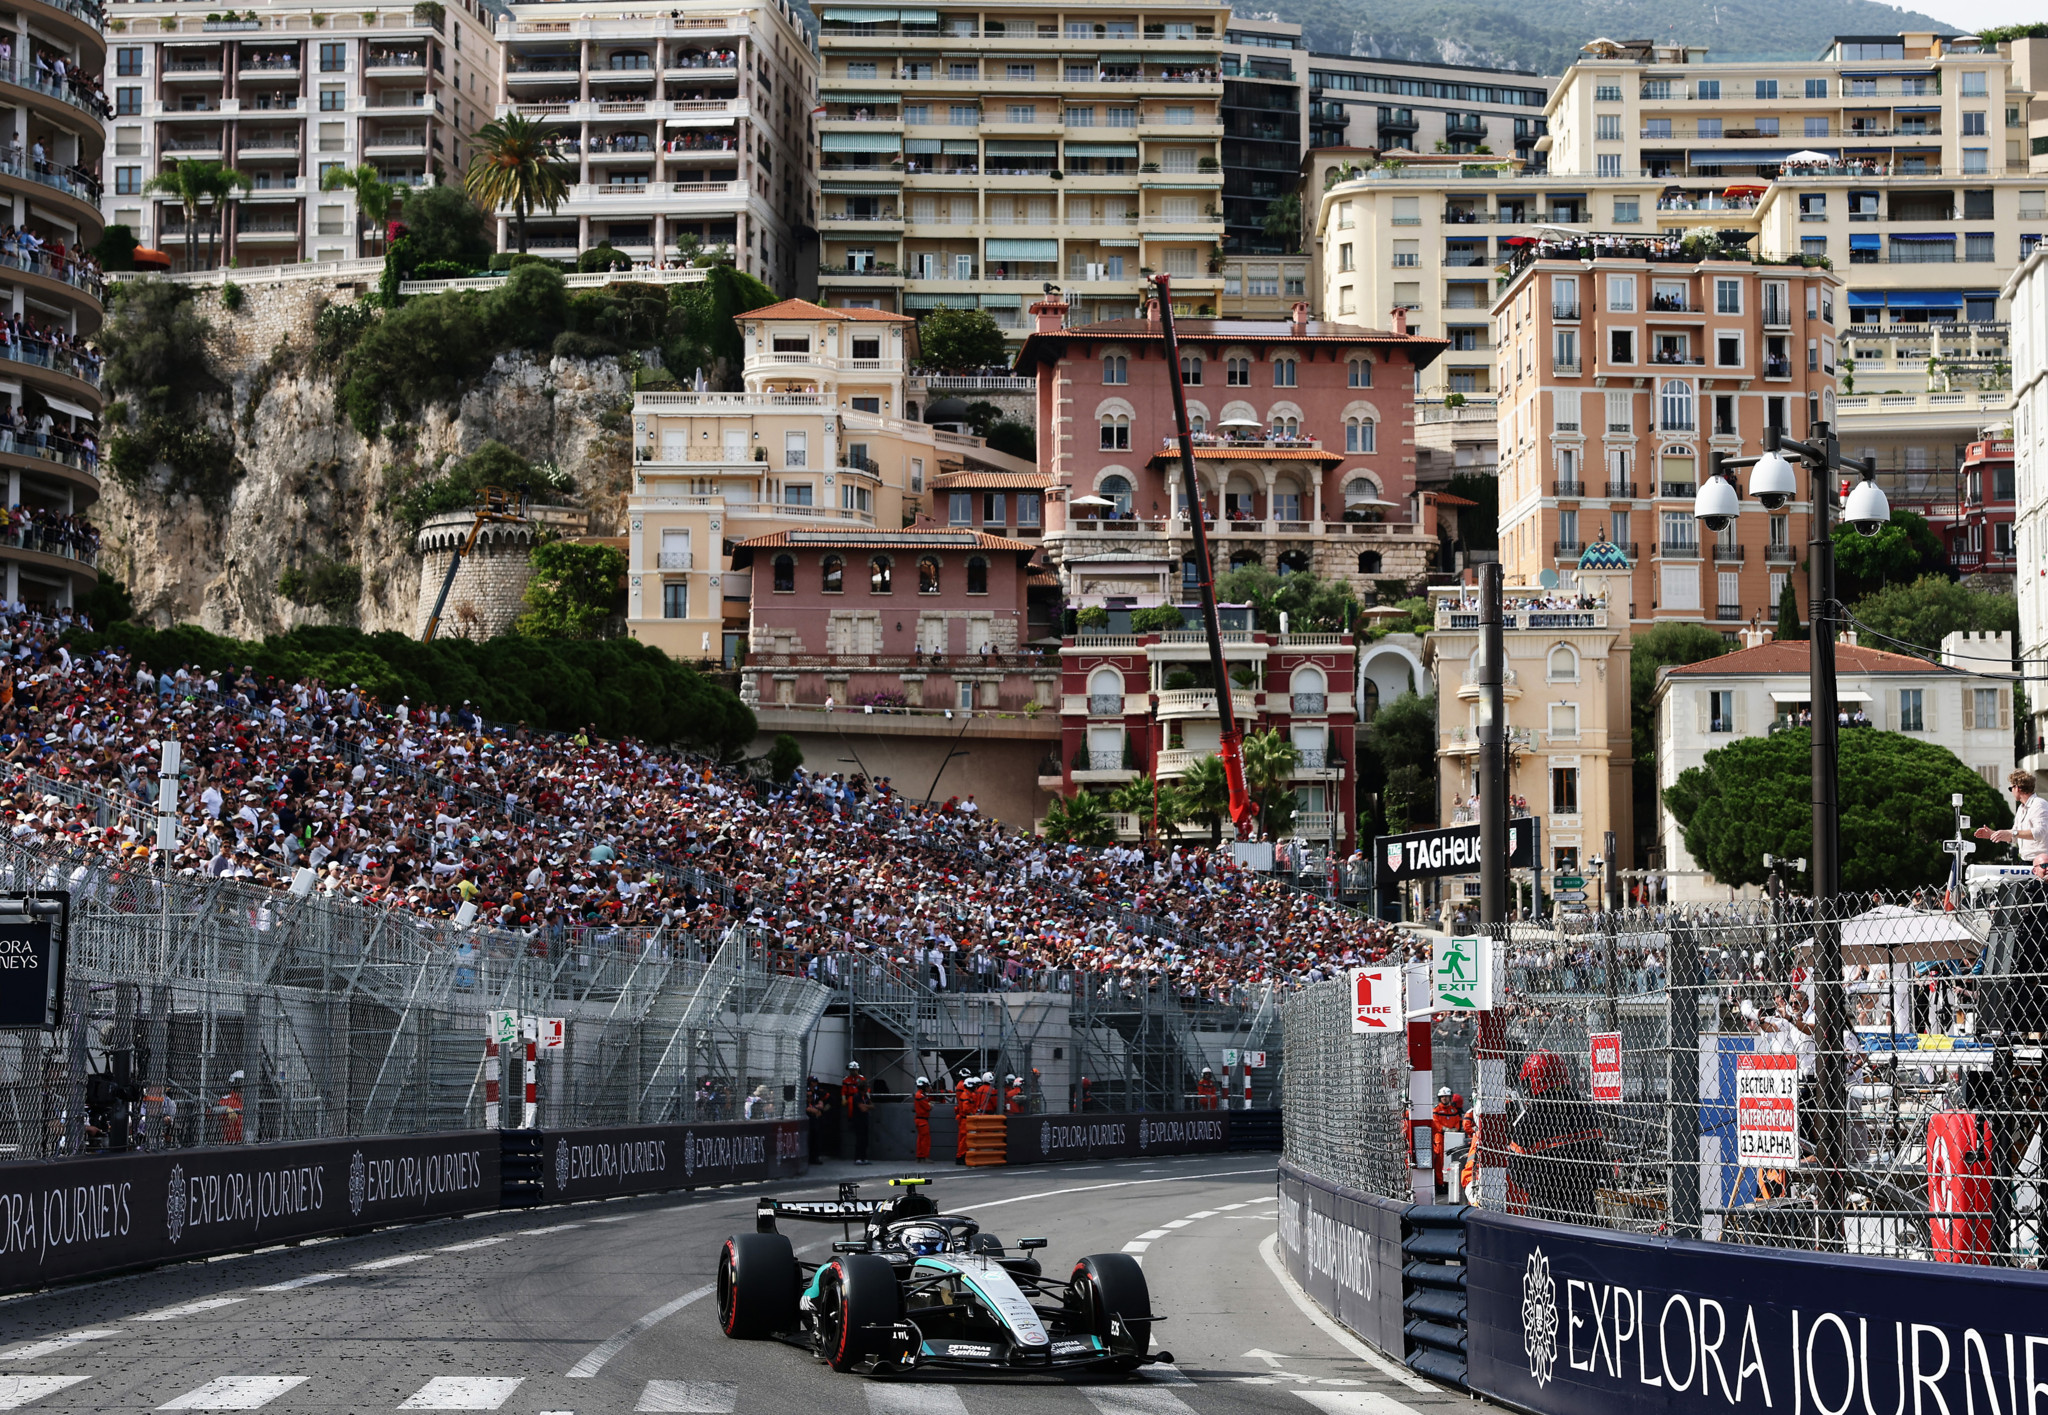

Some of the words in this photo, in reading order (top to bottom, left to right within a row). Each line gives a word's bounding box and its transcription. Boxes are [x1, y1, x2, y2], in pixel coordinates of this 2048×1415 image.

[1406, 836, 1481, 870] TAGHeue
[2000, 868, 2034, 876] FUR
[1438, 983, 1478, 991] EXIT
[1358, 1006, 1391, 1015] FIRE
[1740, 1077, 1775, 1094] SECTEUR
[1781, 1077, 1793, 1094] 13
[1741, 1109, 1793, 1127] INTERVENTION
[1052, 1125, 1087, 1148] EXPLORA
[1088, 1123, 1126, 1151] JOURNEYS
[1150, 1121, 1185, 1143] EXPLORA
[1185, 1120, 1222, 1145] JOURNEYS
[1742, 1135, 1754, 1153] 13
[1757, 1135, 1792, 1154] ALPHA
[571, 1142, 618, 1179] EXPLORA
[619, 1139, 665, 1184] JOURNEYS
[696, 1137, 731, 1168] EXPLORA
[732, 1135, 765, 1173] JOURNEYS
[368, 1156, 423, 1202] EXPLORA
[424, 1150, 480, 1206] JOURNEYS
[189, 1173, 253, 1226] EXPLORA
[255, 1165, 325, 1231] JOURNEYS
[40, 1182, 131, 1266] JOURNEYS
[946, 1349, 990, 1357] Syntium
[1051, 1340, 1080, 1348] ETRONAS
[1567, 1279, 1773, 1408] EXPLORA
